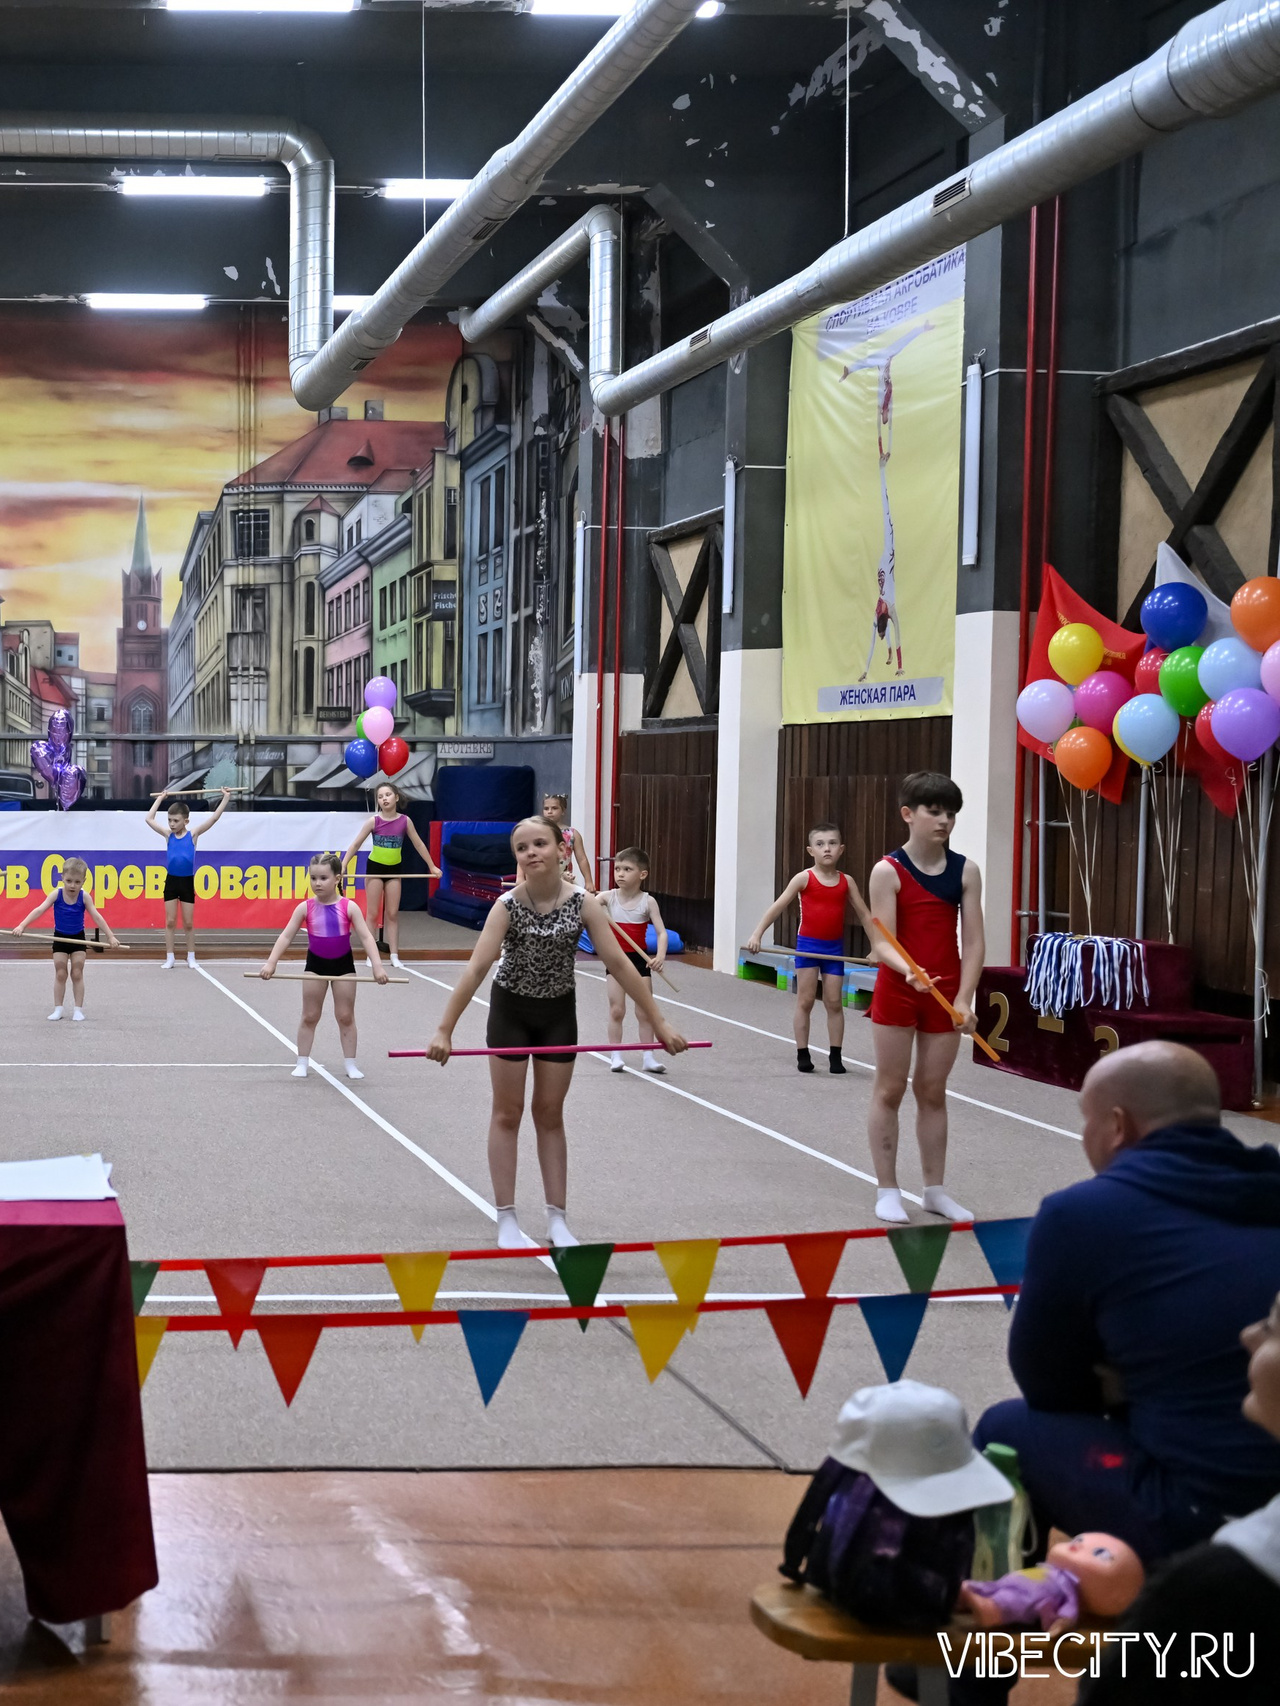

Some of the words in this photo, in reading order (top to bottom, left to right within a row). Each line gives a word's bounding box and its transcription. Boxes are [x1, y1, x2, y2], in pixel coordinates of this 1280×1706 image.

[893, 249, 965, 298] АКРОБАТИКА
[882, 296, 918, 325] КОВРЕ
[839, 686, 887, 706] ЖЕНСКАЯ
[889, 684, 917, 703] ПАРА
[40, 851, 358, 909] Сревовани!
[987, 991, 1010, 1052] 2
